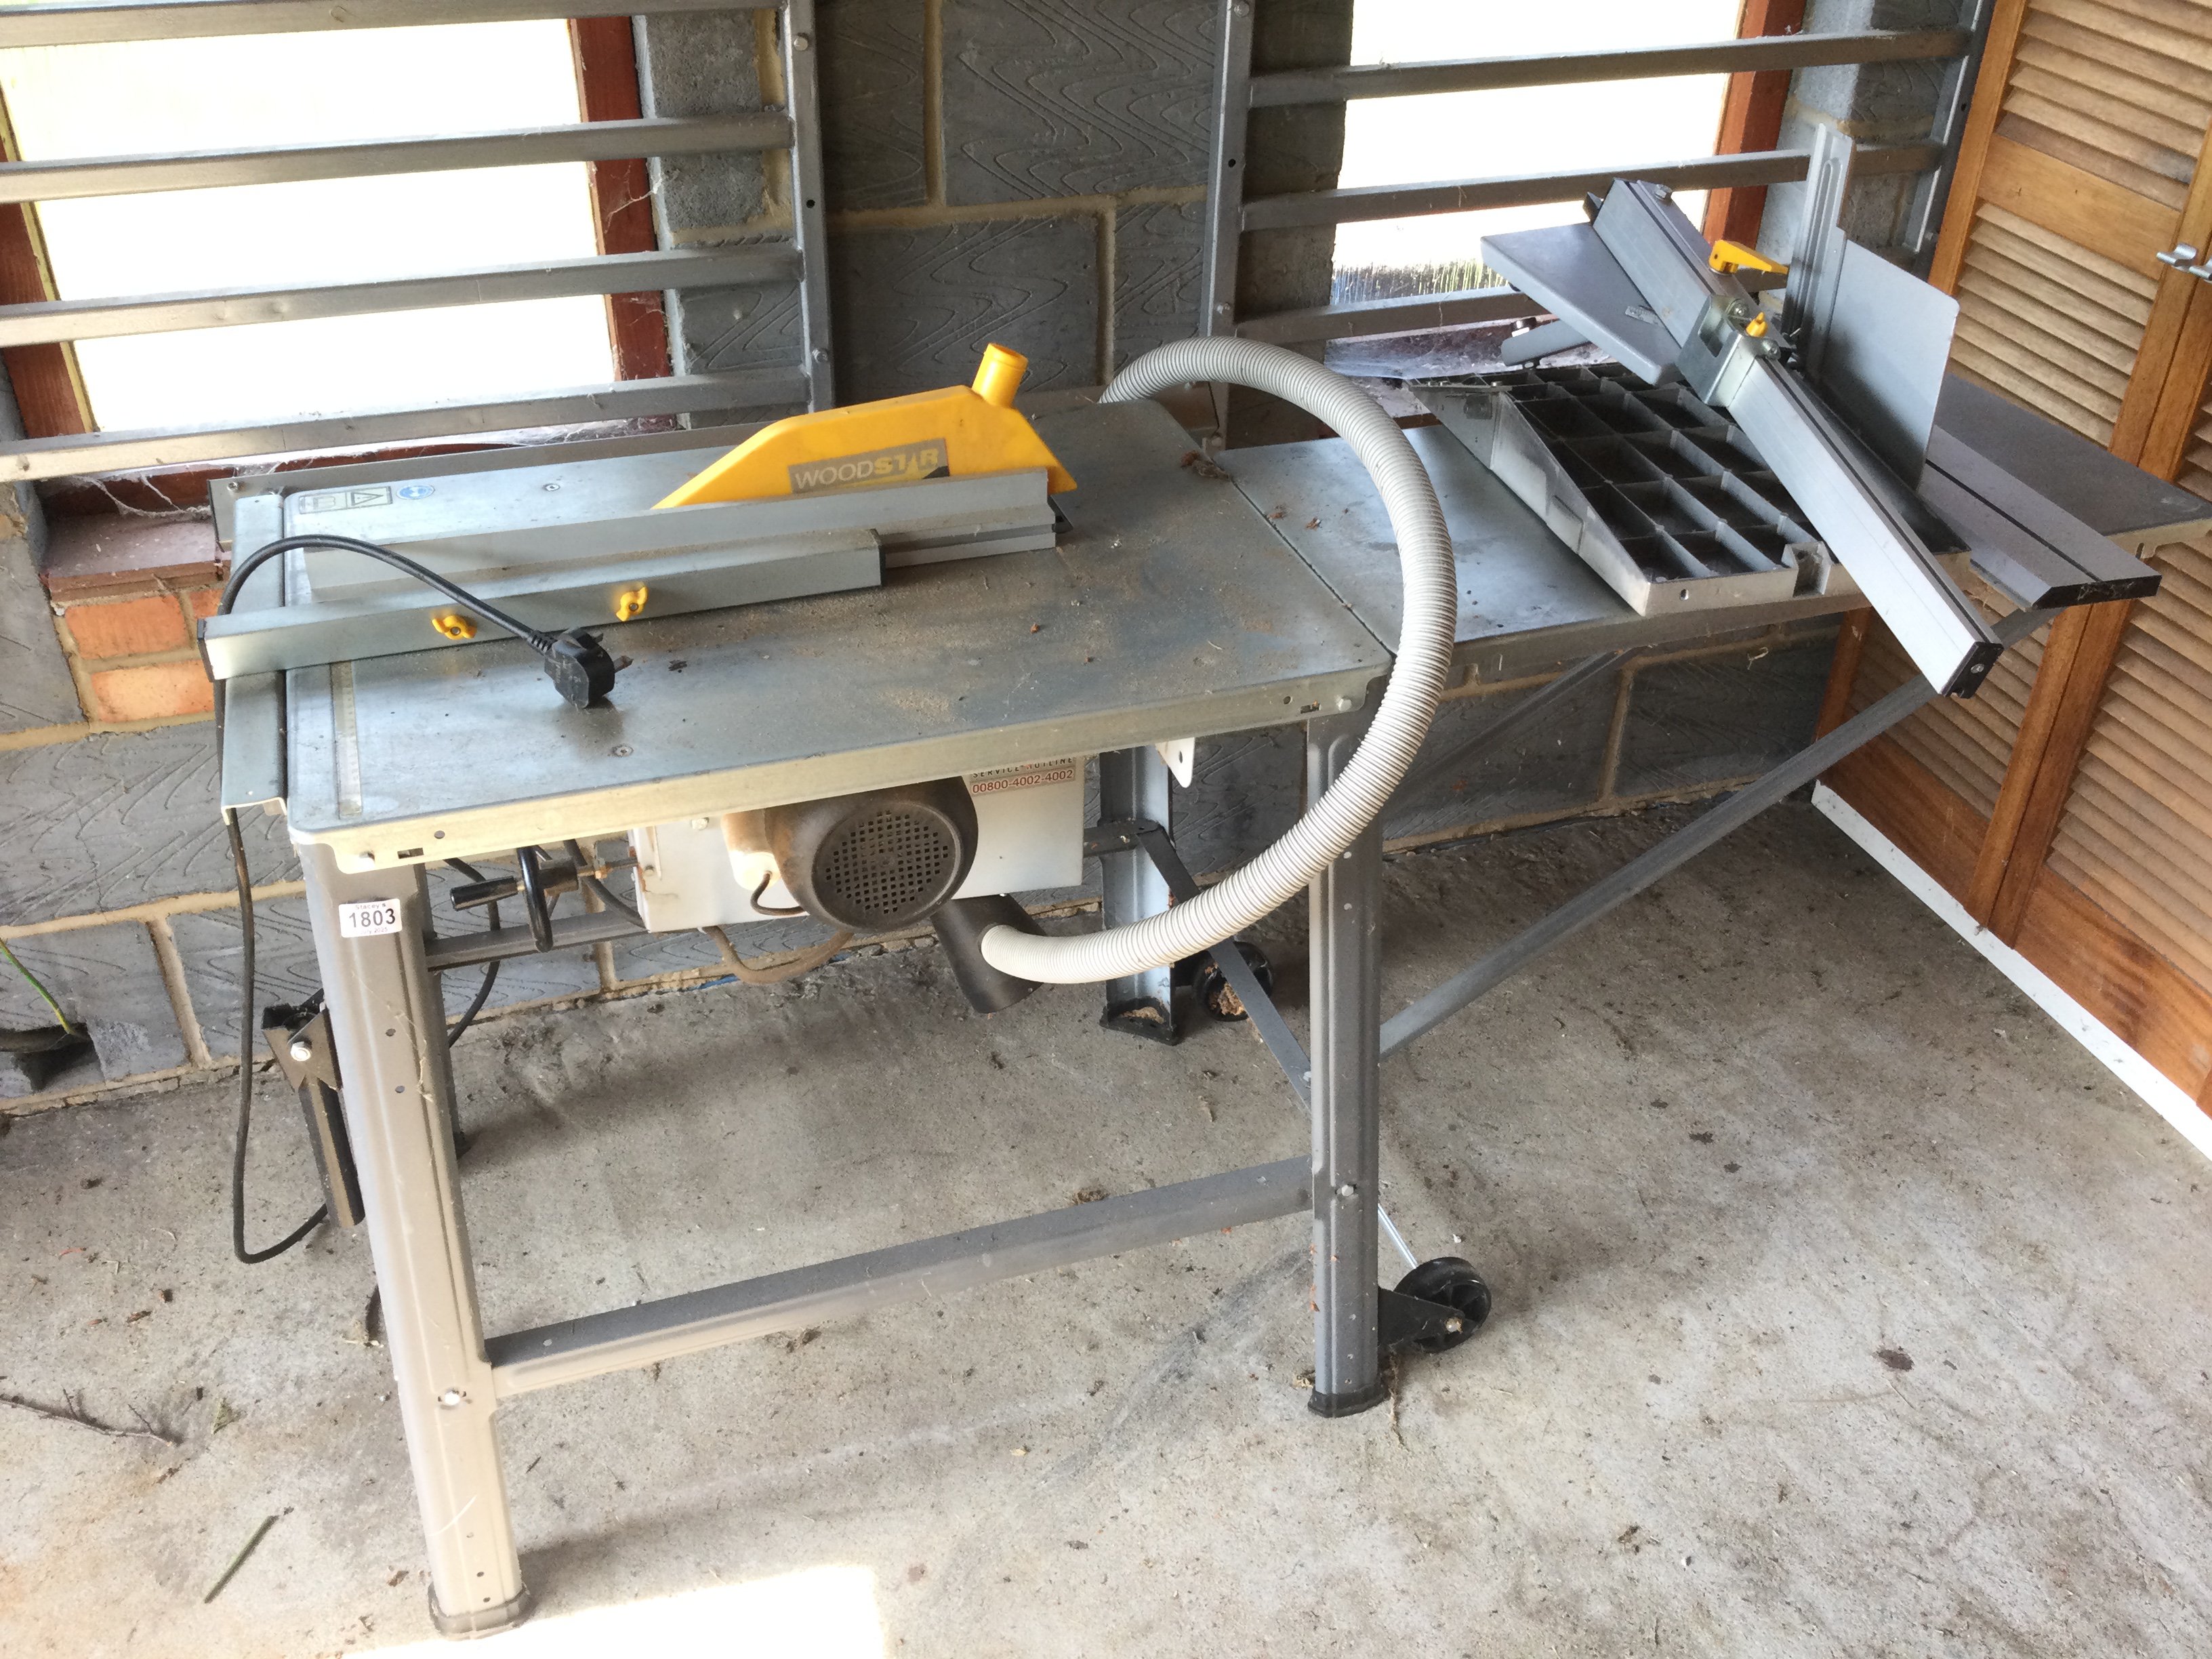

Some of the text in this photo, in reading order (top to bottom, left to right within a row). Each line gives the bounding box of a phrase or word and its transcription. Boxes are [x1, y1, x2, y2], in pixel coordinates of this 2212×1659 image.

[796, 448, 939, 489] WOODSTAR
[972, 770, 1073, 793] 00800-4002-4002
[349, 908, 396, 928] 1803
